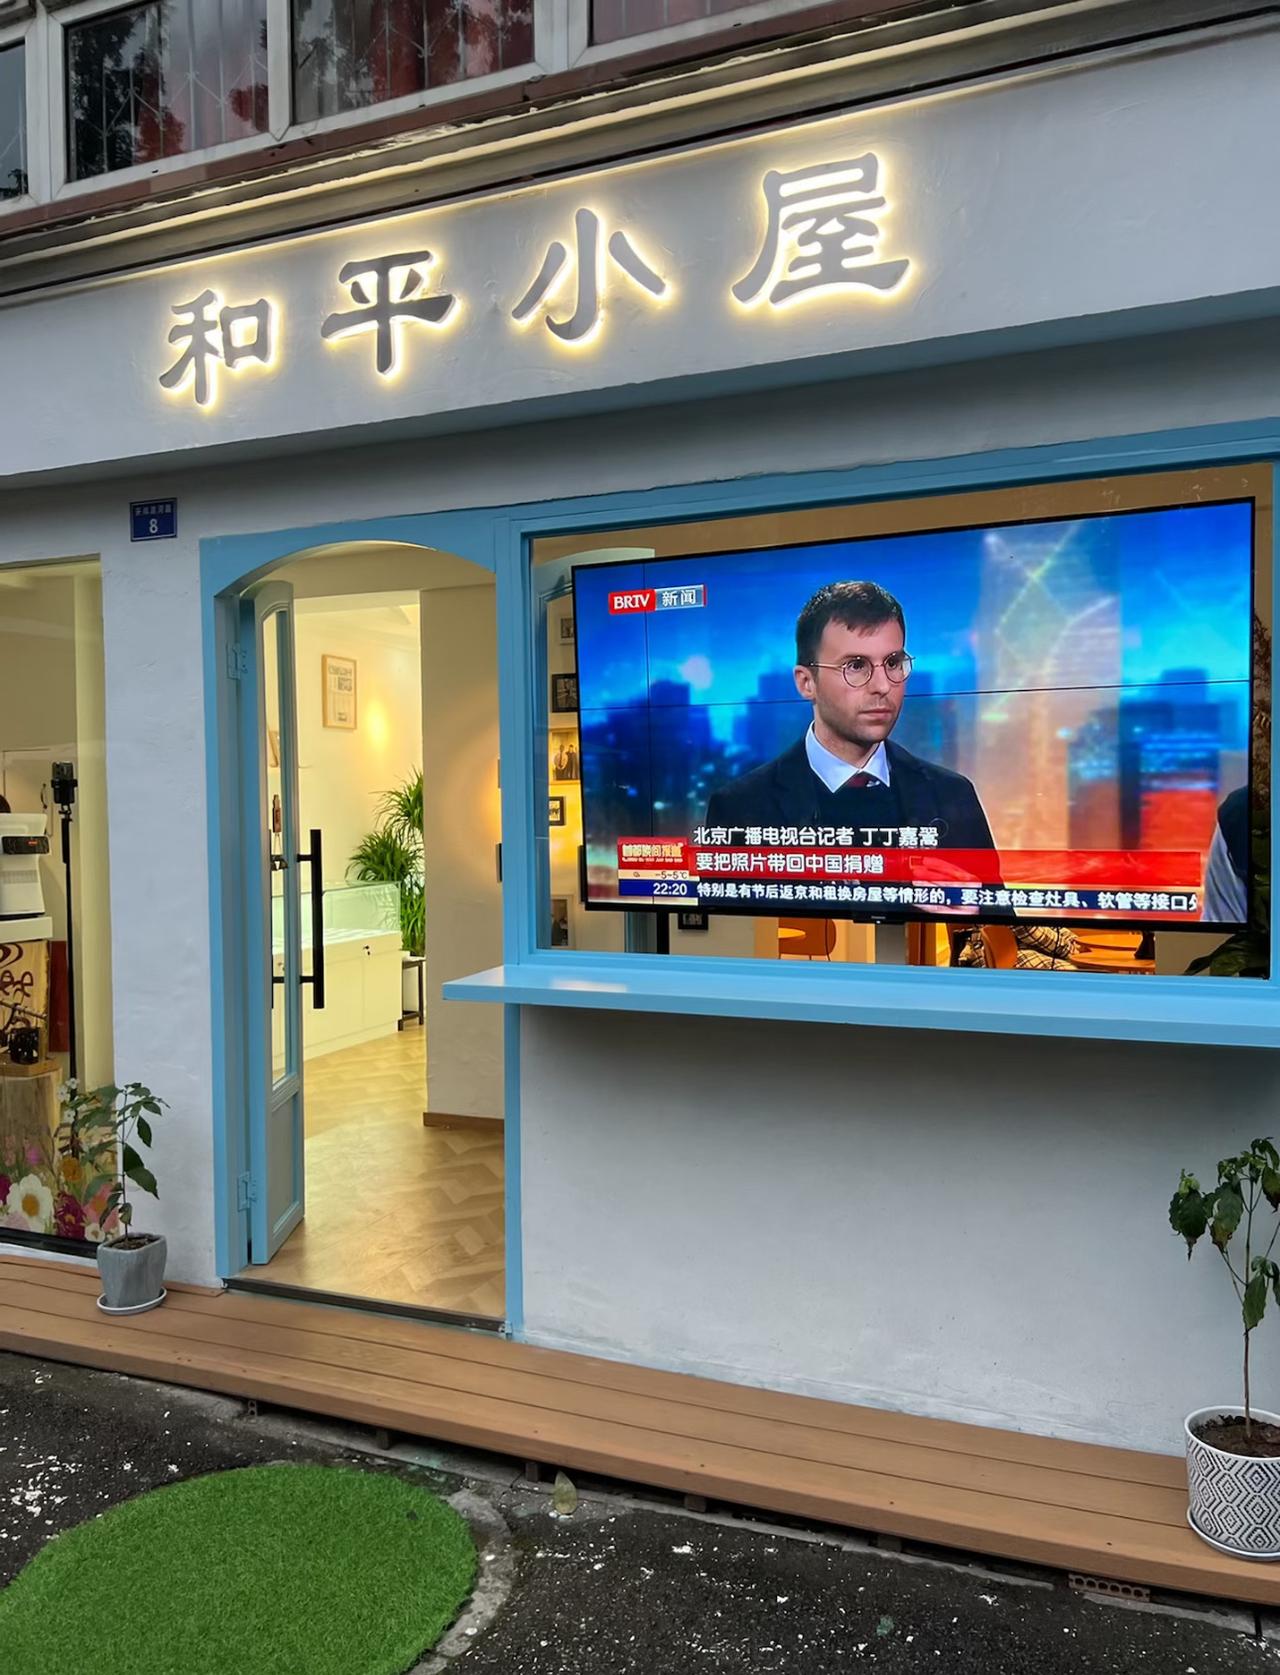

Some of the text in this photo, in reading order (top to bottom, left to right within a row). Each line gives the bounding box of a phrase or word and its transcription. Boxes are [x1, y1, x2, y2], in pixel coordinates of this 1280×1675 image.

[159, 151, 911, 405] 和平小屋
[149, 518, 159, 534] 8
[613, 589, 697, 610] BRTV 新闻
[693, 825, 855, 846] 北京广播电视台记者
[696, 852, 884, 874] 要把照片带回中国捐赠
[652, 882, 688, 896] 22:20
